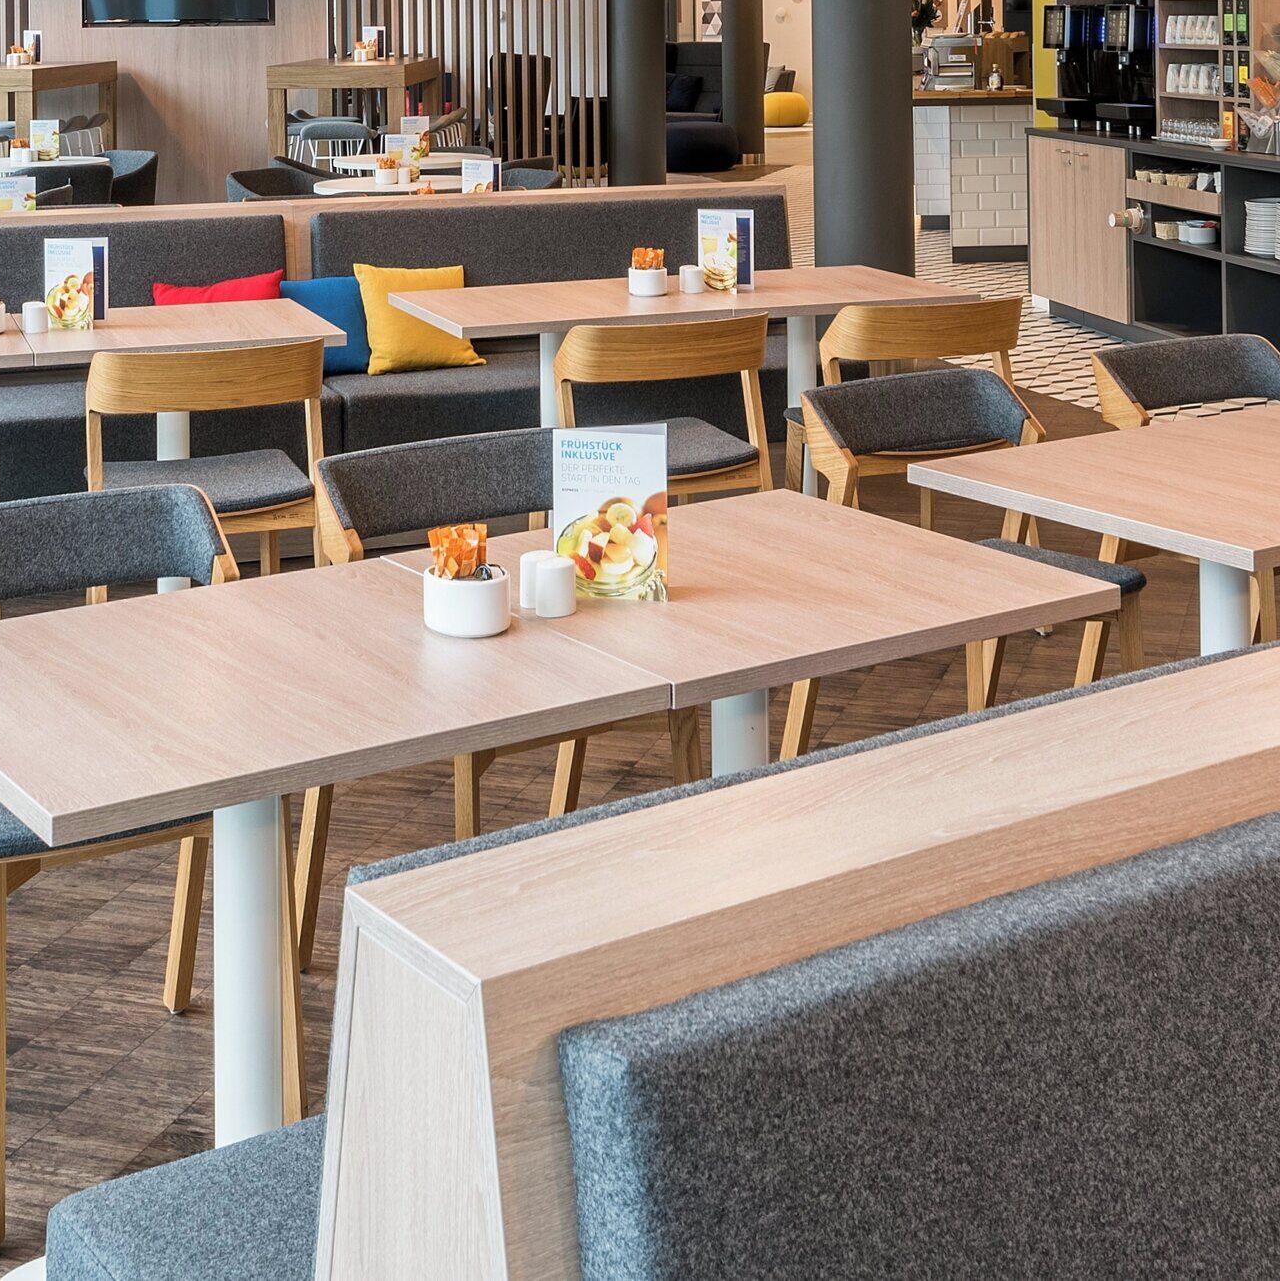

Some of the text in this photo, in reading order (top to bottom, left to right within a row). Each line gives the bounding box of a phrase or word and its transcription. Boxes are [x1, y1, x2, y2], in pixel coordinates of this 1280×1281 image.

[560, 438, 623, 451] FRÜHSTÜCK
[560, 451, 616, 461] INKLUSIVE
[561, 463, 625, 475] DER PERFEKTE
[561, 473, 641, 486] START IN DEN TAG
